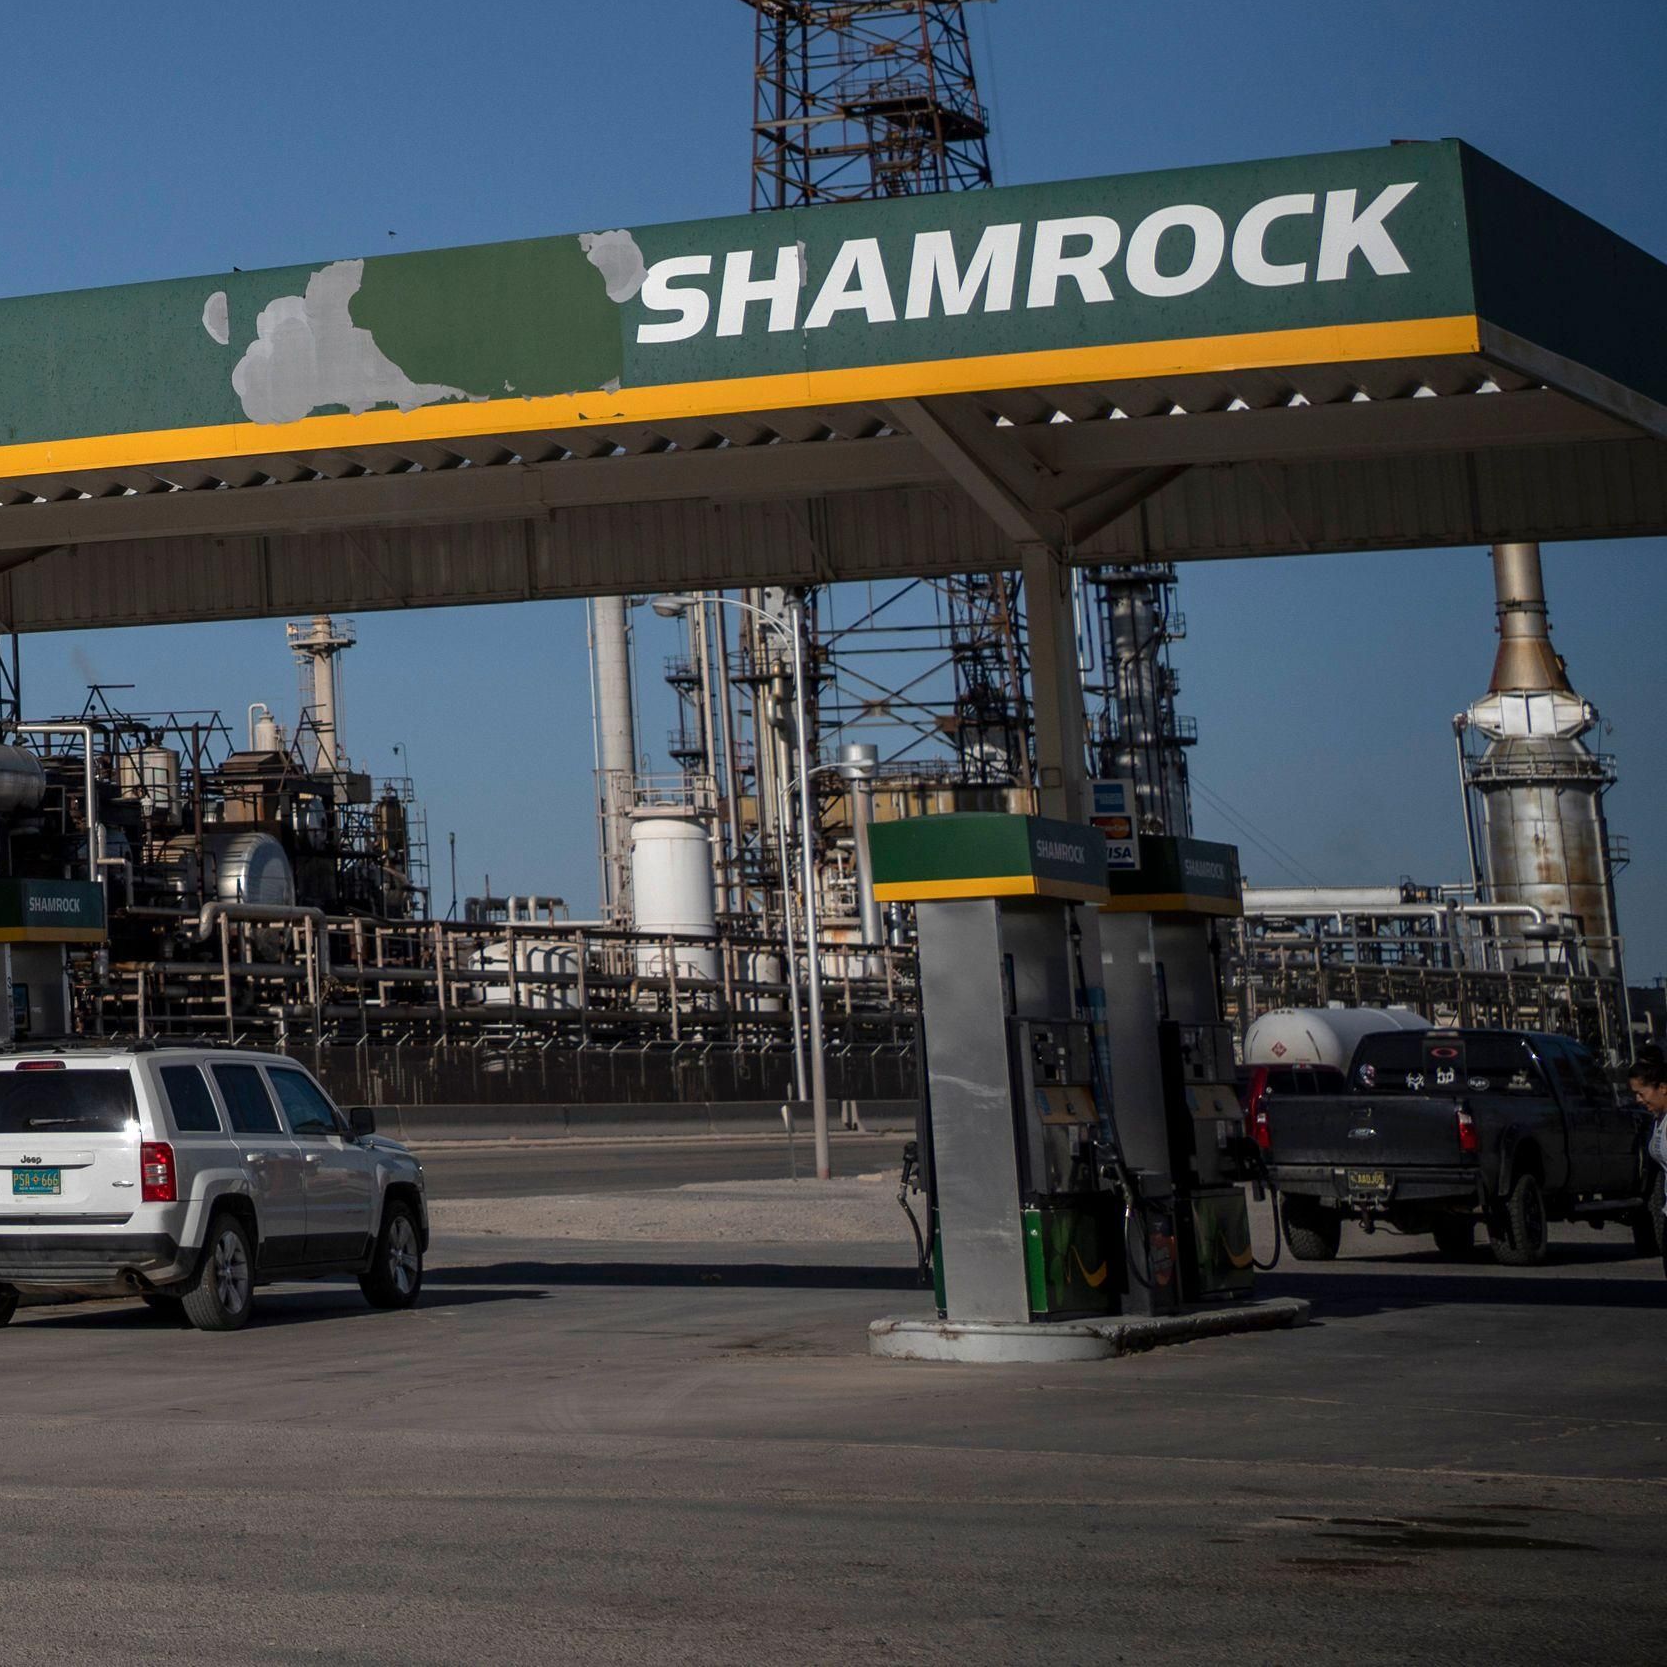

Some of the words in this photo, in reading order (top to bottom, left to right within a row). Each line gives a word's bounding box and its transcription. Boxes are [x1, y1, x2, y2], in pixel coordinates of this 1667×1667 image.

[636, 181, 1419, 344] SHAMROCK
[1036, 839, 1086, 865] SHAMROCK
[1106, 846, 1132, 860] ISA
[1184, 859, 1225, 881] SHAMROCK
[29, 896, 80, 913] SHAMROCK
[20, 1154, 42, 1165] Jeep
